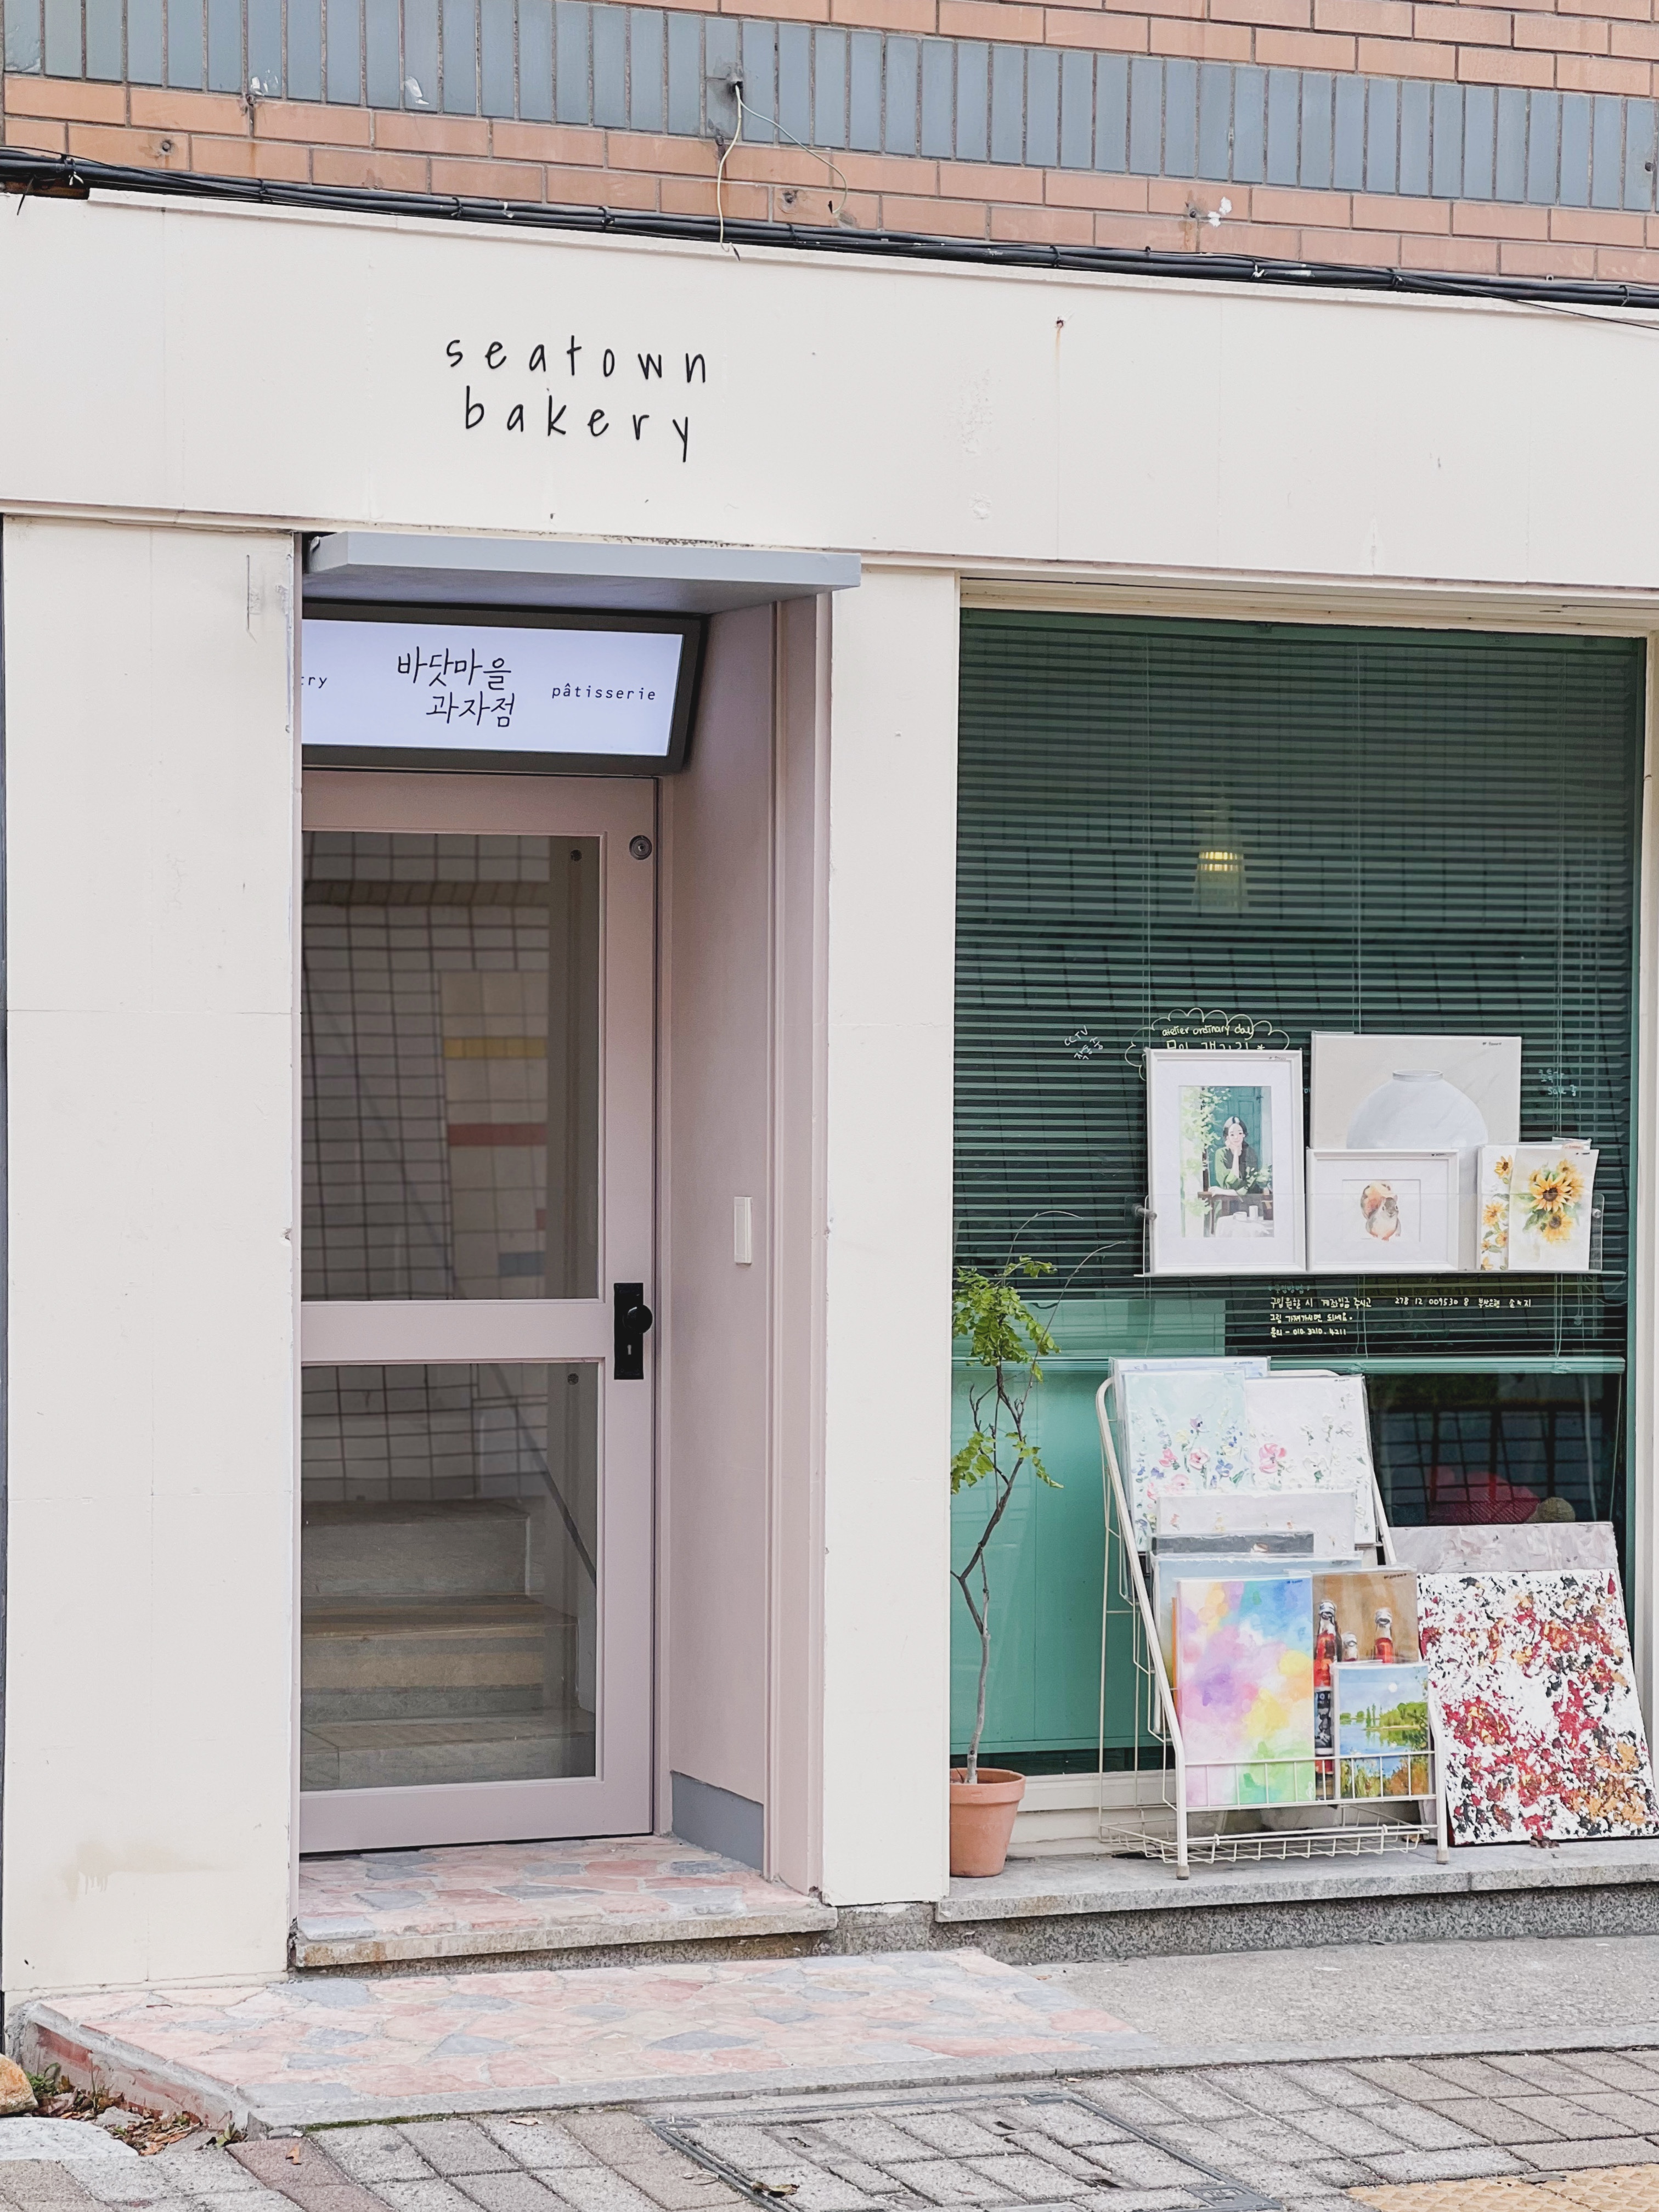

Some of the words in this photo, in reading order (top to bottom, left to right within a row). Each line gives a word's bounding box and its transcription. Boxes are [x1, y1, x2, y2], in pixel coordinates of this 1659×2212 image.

[446, 335, 706, 383] seatown
[465, 385, 689, 463] bakery
[398, 646, 512, 691] 바닷마을
[552, 683, 656, 701] pâtisserie
[426, 692, 515, 728] 과자점
[1064, 1025, 1088, 1046] CCTV
[1162, 1026, 1189, 1037] atelier
[1193, 1025, 1230, 1036] ordinary
[1234, 1023, 1254, 1041] day
[1395, 1297, 1409, 1305] 278
[1464, 1297, 1469, 1306] 8
[1270, 1314, 1282, 1323] 그림
[1285, 1314, 1323, 1323] 가져가시면
[1271, 1327, 1283, 1338] 문의
